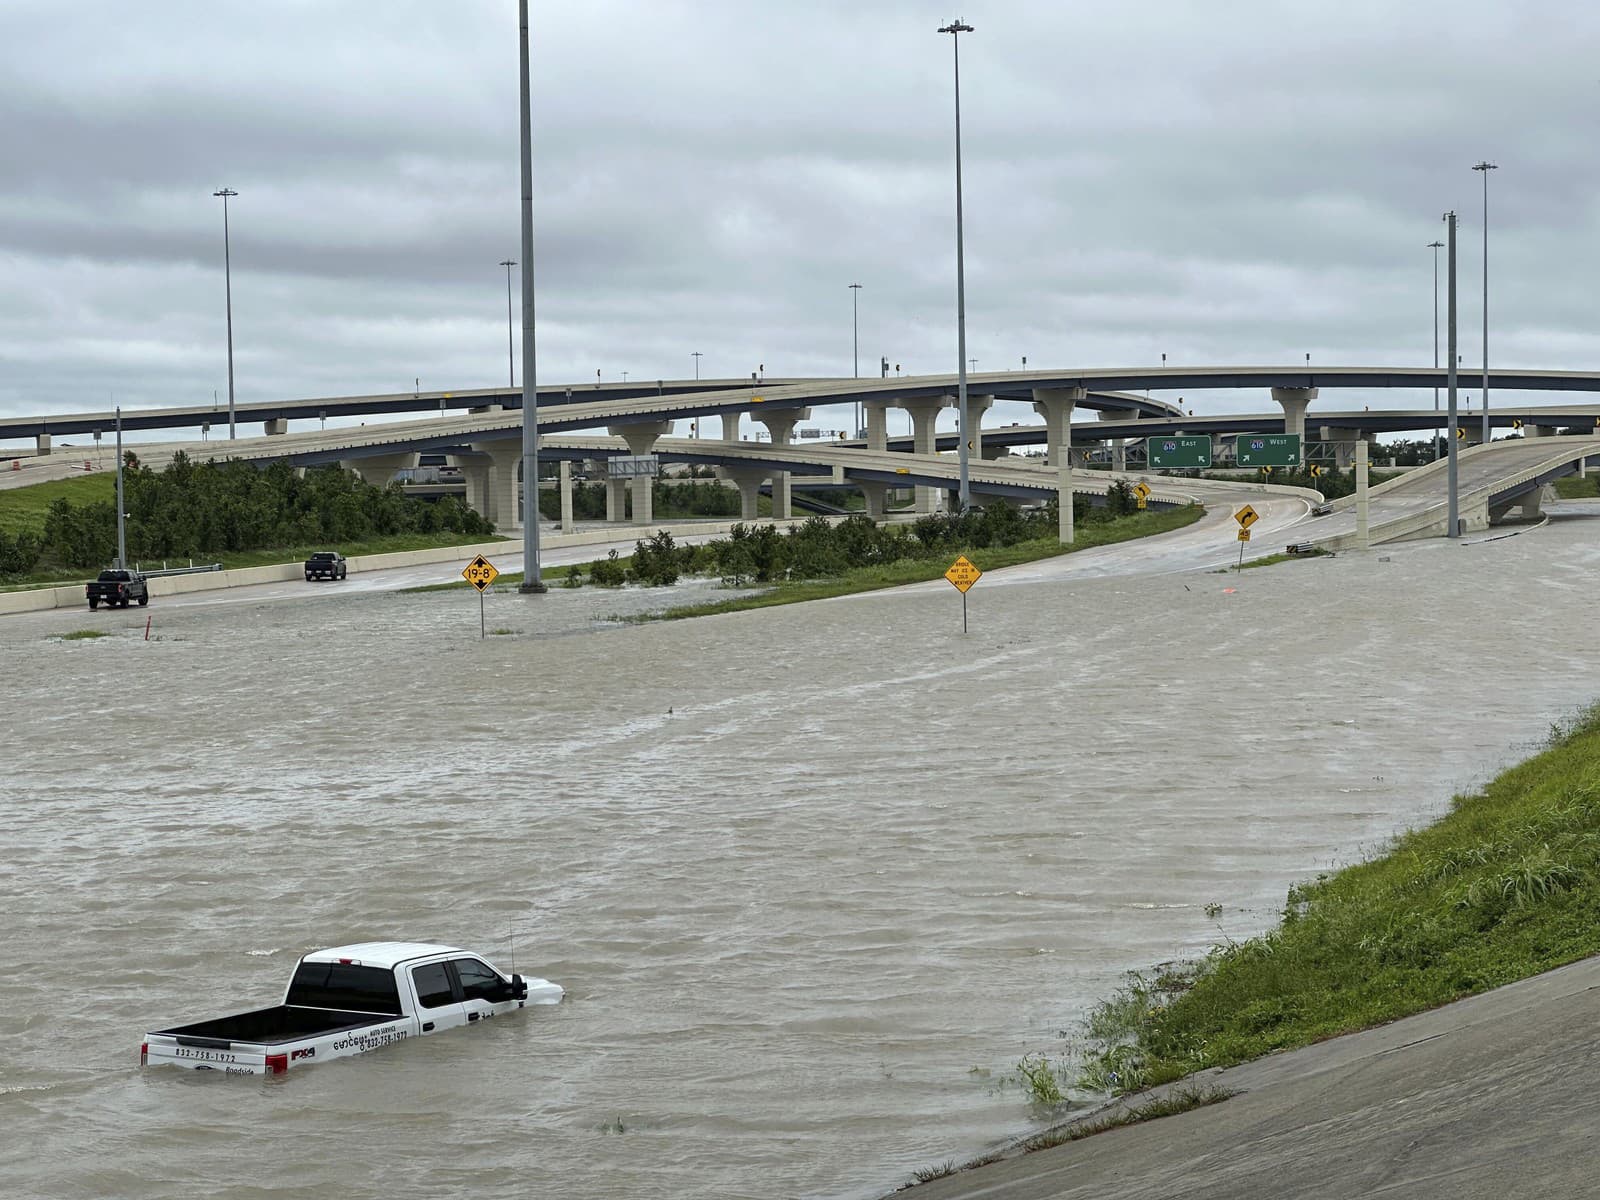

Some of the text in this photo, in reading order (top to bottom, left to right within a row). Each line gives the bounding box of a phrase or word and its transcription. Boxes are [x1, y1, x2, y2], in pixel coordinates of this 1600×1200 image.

[1163, 442, 1176, 451] 610
[1251, 441, 1264, 449] 610
[370, 1025, 396, 1037] AUTO SERVICE
[175, 1048, 236, 1063] 832-758-1972
[291, 1047, 315, 1061] FX4
